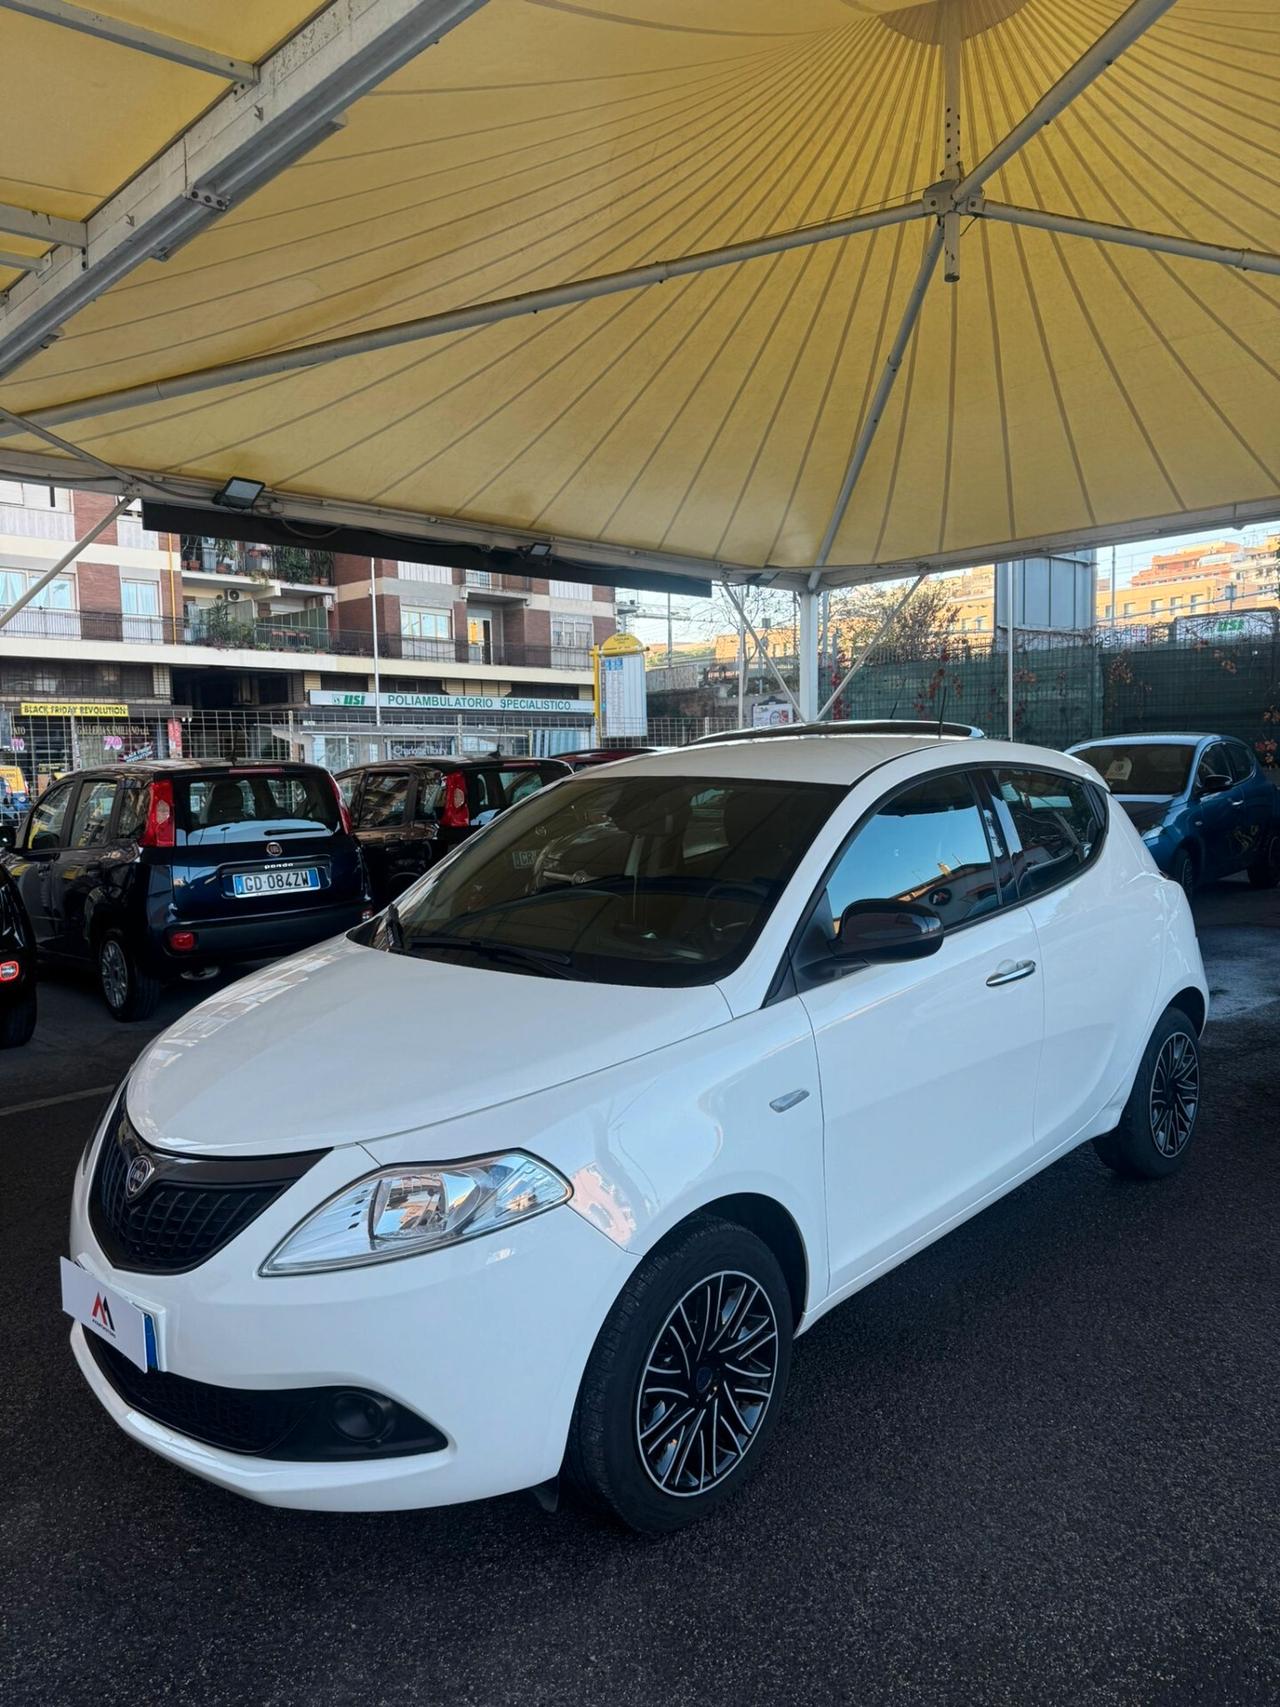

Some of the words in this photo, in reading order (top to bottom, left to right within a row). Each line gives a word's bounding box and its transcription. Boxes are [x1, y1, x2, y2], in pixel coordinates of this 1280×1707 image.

[343, 694, 366, 705] USI
[388, 694, 493, 708] POLIAMBULATORIO
[500, 698, 571, 710] SPECIALISTICO
[24, 705, 47, 714] BLACK
[51, 705, 77, 714] FRIDAY
[80, 706, 126, 715] REVOLUTION
[244, 876, 262, 891] GD
[267, 871, 309, 889] 084ZW
